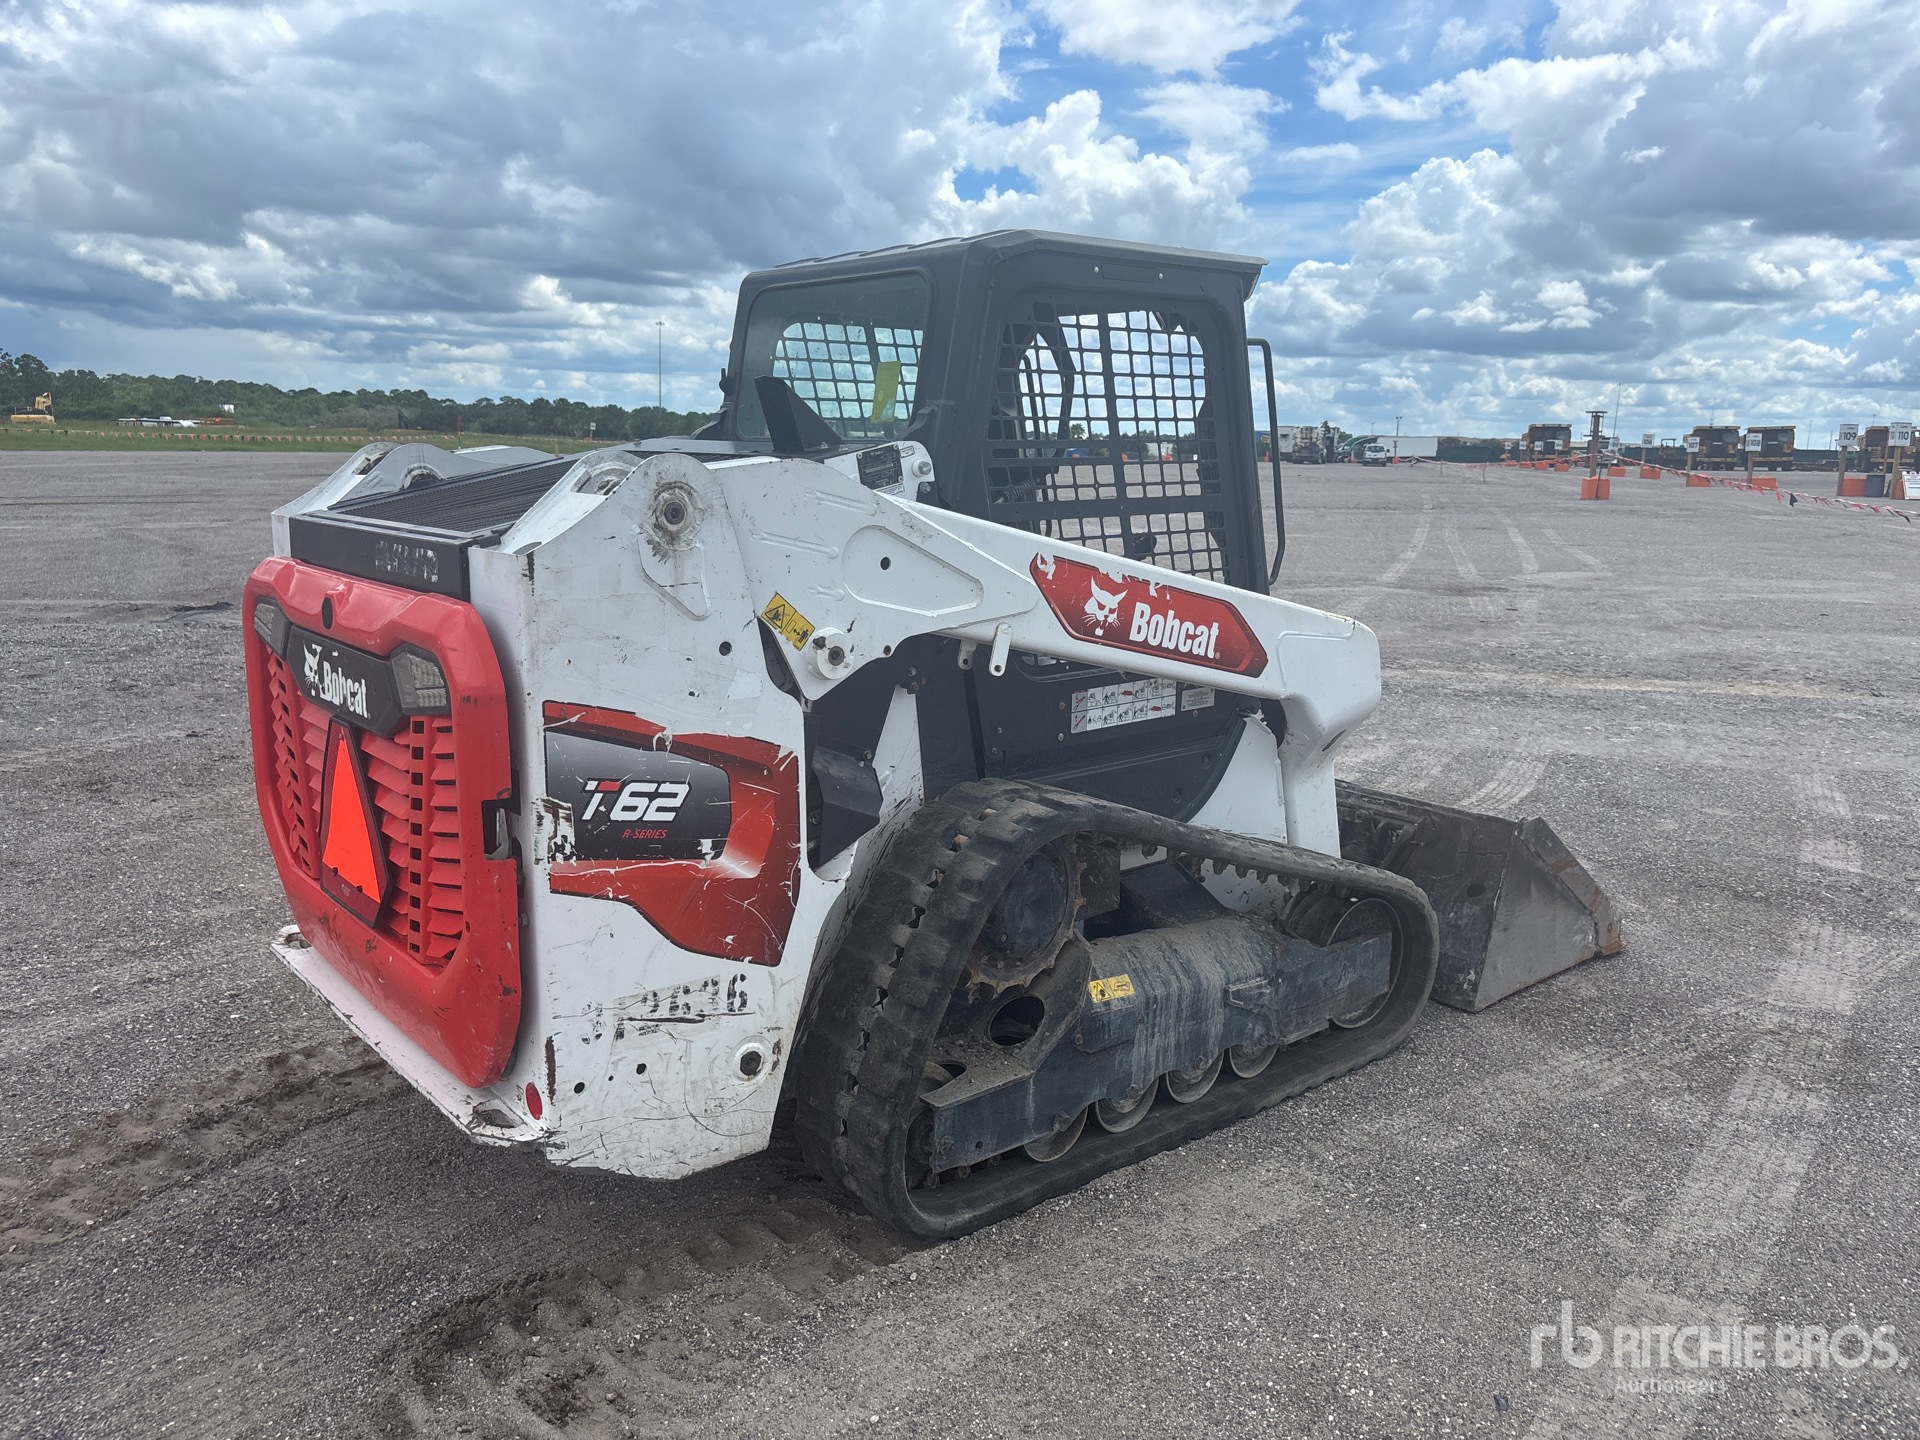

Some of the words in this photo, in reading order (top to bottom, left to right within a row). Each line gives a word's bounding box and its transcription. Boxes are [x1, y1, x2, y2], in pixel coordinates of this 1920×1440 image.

[1843, 431, 1857, 441] 109
[1898, 431, 1909, 440] 110
[1129, 601, 1219, 659] Bobcat
[320, 661, 368, 720] Bobcat
[622, 828, 668, 839] R-SERIES
